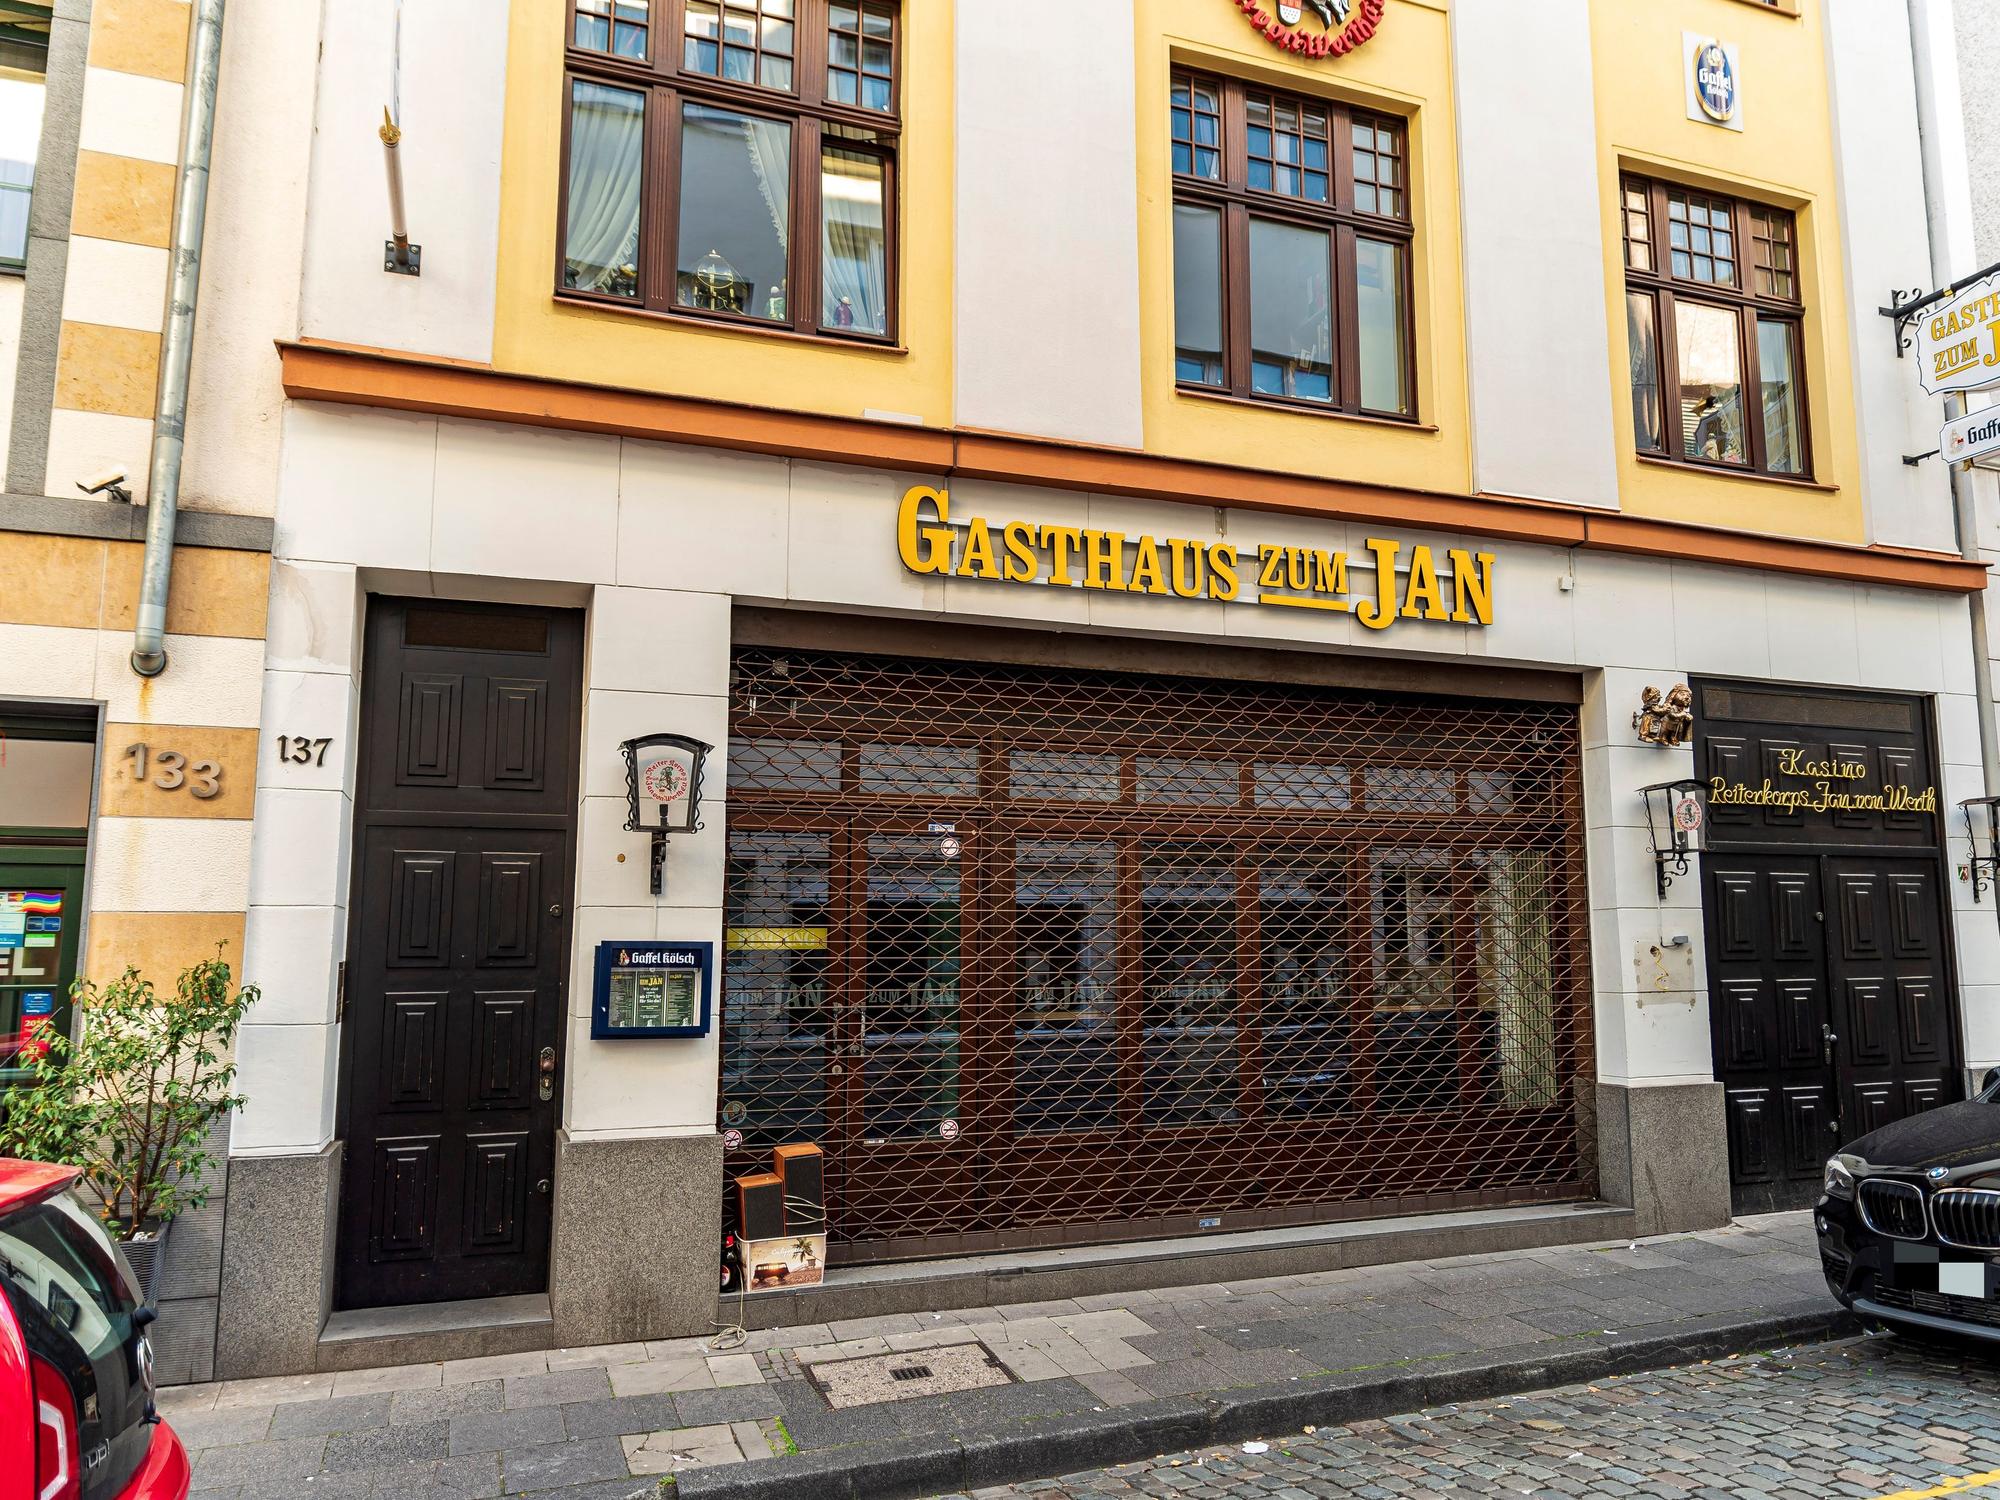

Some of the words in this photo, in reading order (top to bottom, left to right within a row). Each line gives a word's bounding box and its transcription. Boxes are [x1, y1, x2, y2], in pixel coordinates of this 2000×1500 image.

[1933, 336, 1980, 374] ZUM
[1967, 417, 2000, 445] Gaff
[897, 485, 1240, 601] GASTHAUS
[1258, 543, 1348, 594] ZUM
[1355, 537, 1496, 630] JAN
[276, 734, 333, 768] 137
[1779, 748, 1866, 780] Kasino
[126, 742, 221, 799] 133
[1708, 776, 1810, 815] Reiterkorps
[1883, 784, 1937, 814] Werth
[632, 952, 661, 964] Gaffel
[662, 952, 695, 965] Kölsch
[649, 977, 663, 986] JAN
[1059, 980, 1108, 1010] JAN
[766, 983, 823, 1014] JAN
[868, 990, 900, 1003] ZUM
[903, 982, 960, 1013] JAN
[88, 1438, 110, 1468] up!
